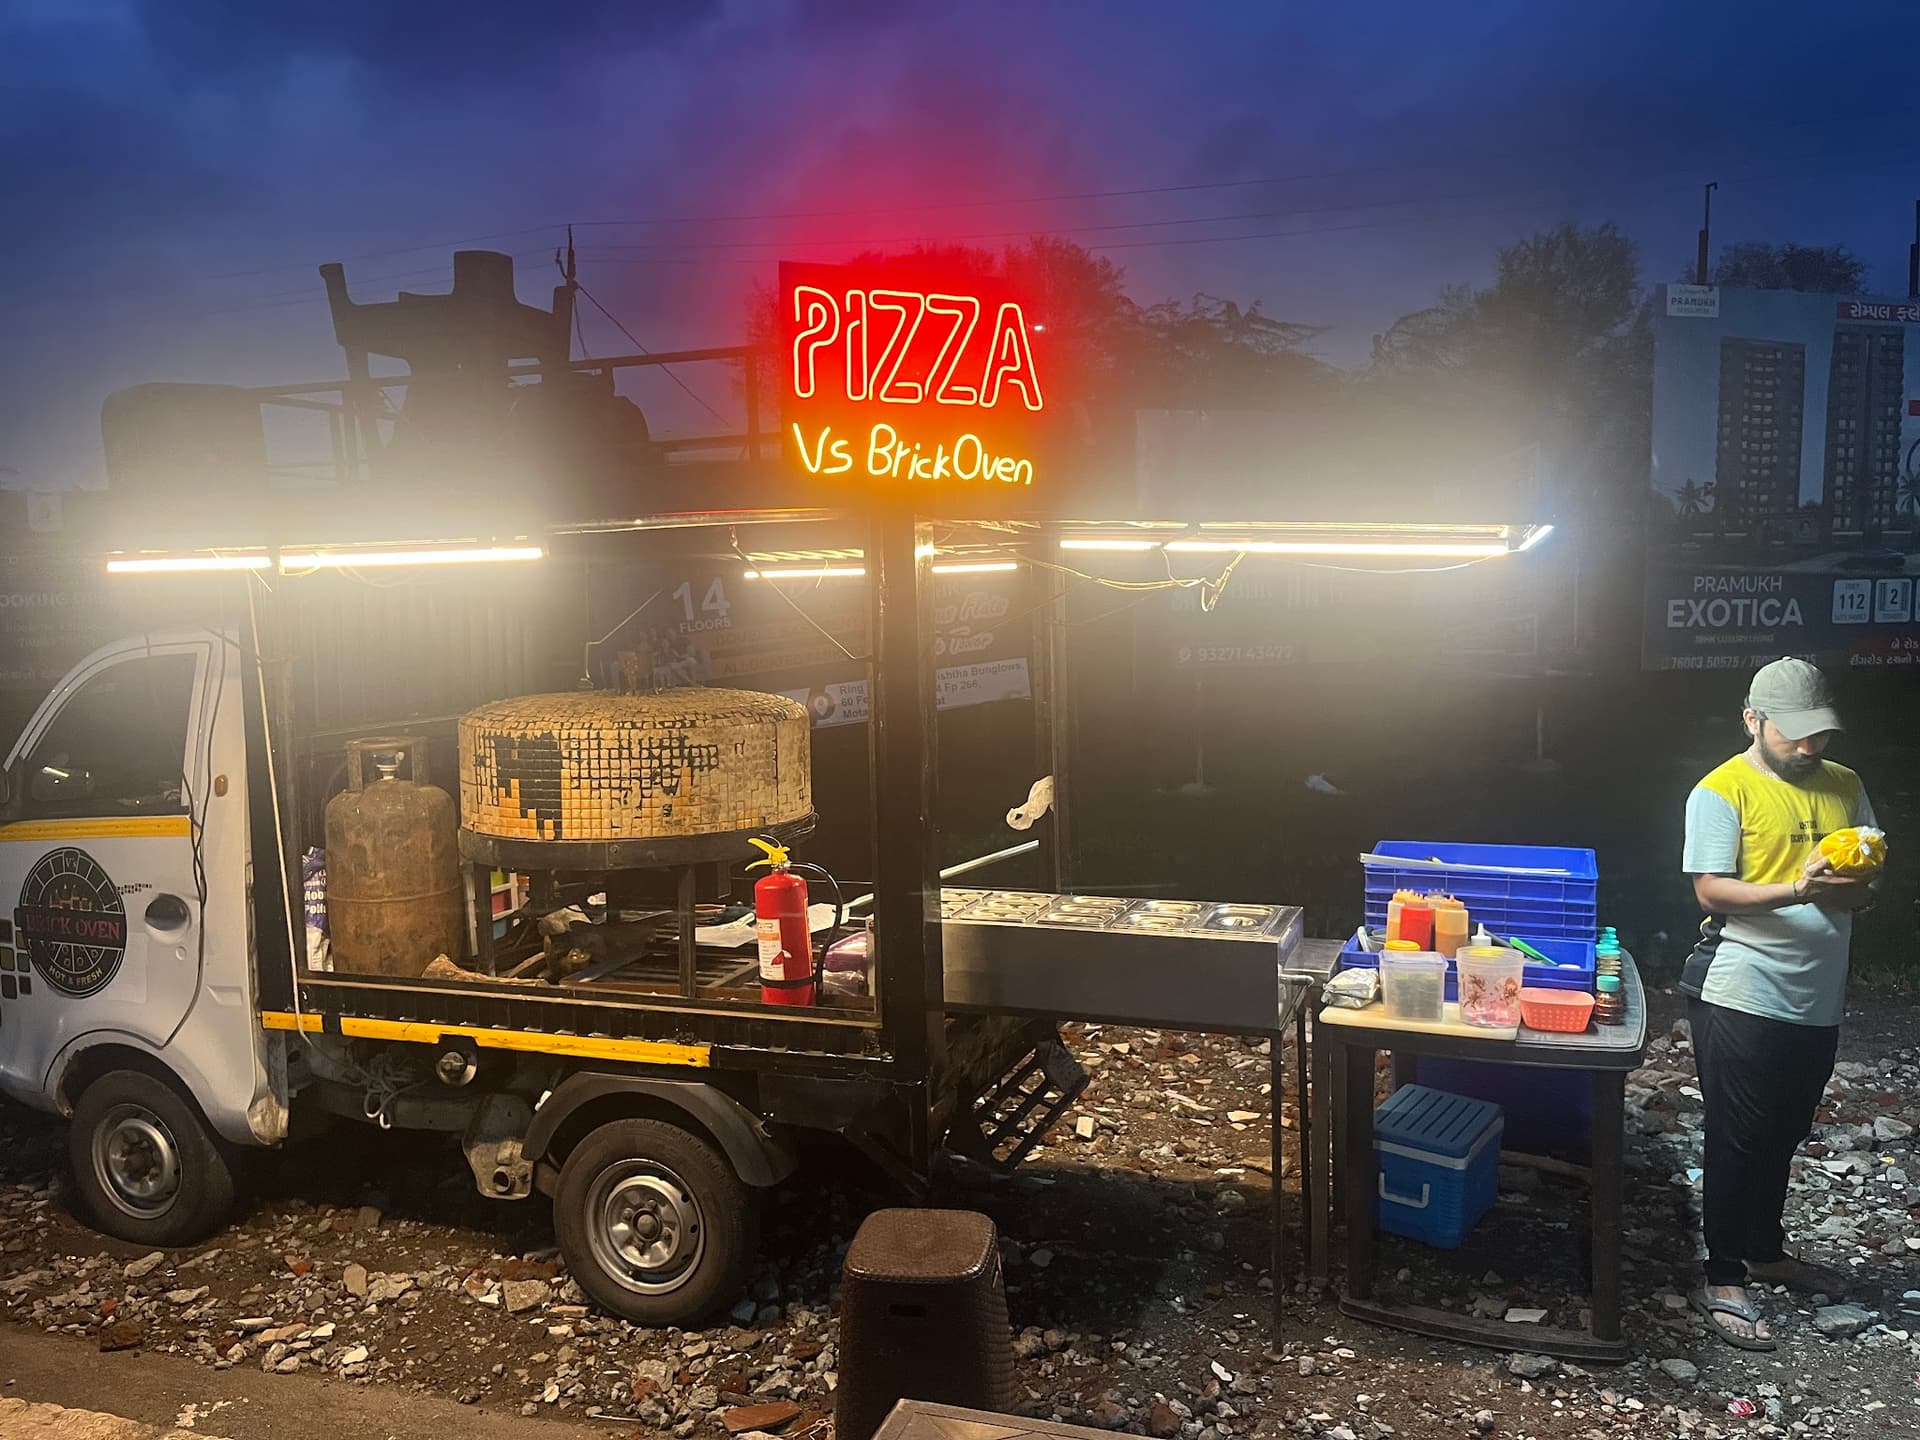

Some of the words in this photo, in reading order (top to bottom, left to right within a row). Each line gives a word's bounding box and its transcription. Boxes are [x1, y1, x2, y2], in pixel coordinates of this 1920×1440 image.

[794, 286, 1043, 410] PIZZA
[793, 422, 854, 474] Vs
[1694, 576, 1782, 592] PRAMUKH
[672, 577, 731, 620] 14
[1840, 593, 1865, 610] 112
[1890, 588, 1898, 605] 2
[679, 616, 731, 633] FLOORS
[1667, 598, 1804, 629] EXOTICA
